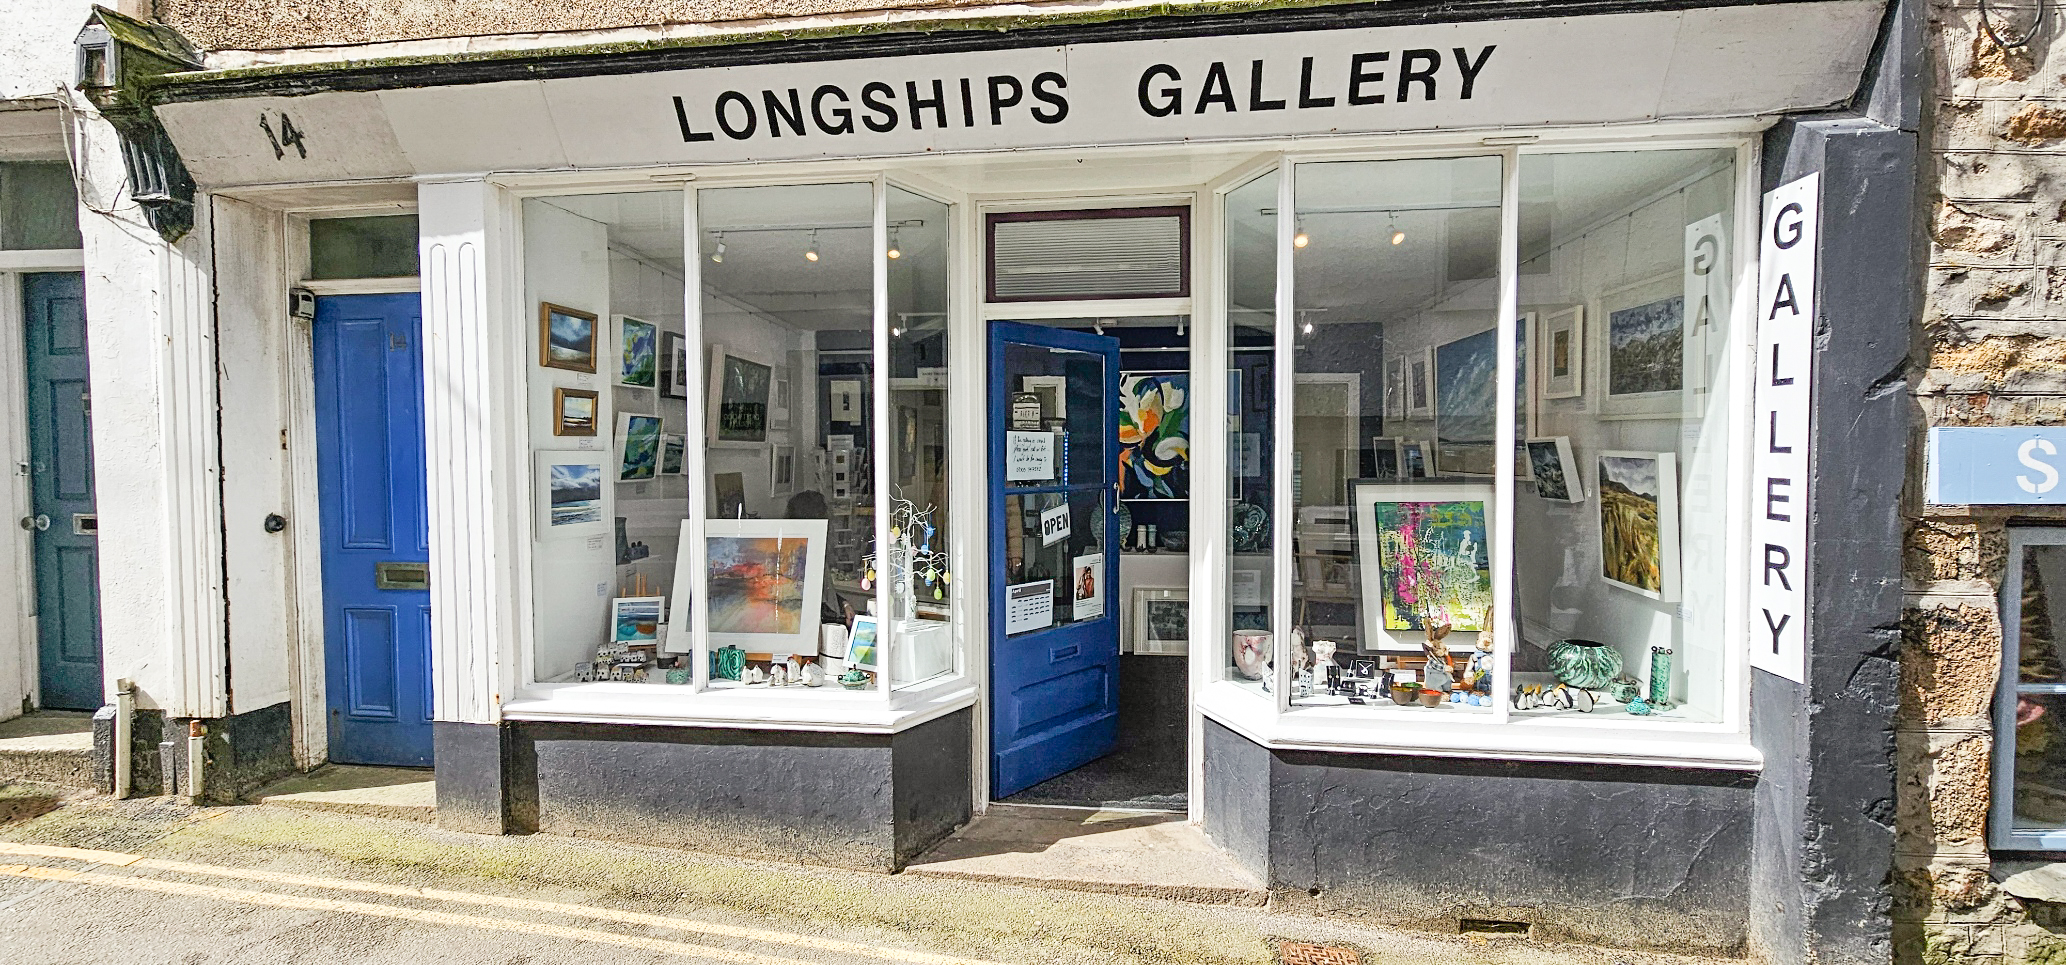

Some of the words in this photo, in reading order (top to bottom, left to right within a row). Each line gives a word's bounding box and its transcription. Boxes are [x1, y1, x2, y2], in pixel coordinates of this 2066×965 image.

[672, 71, 1069, 143] LONGSHIPS
[1137, 44, 1497, 118] GALLERY
[259, 112, 307, 161] 14
[389, 331, 407, 352] 14
[1762, 202, 1804, 656] GALLERY
[2016, 438, 2059, 494] S
[1044, 512, 1069, 536] OPEN
